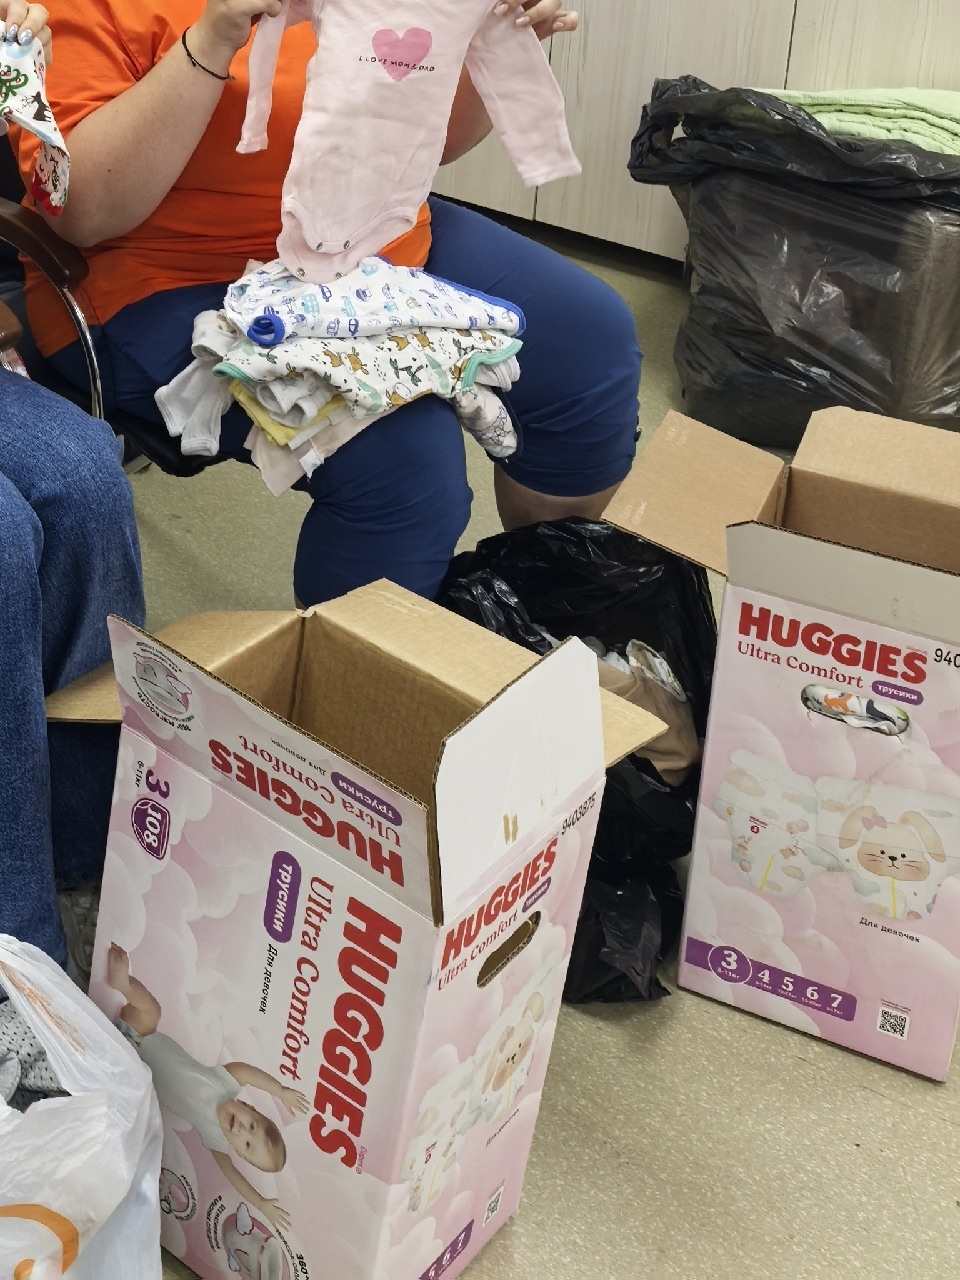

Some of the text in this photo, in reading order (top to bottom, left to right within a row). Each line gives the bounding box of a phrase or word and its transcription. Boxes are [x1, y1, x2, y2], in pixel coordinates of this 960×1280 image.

[737, 640, 864, 689] Ultra Comfort
[738, 602, 928, 684] HUGGIES
[145, 768, 170, 799] 3
[208, 739, 405, 887] HUGGIES
[239, 735, 402, 848] Ultra Comfort
[339, 778, 395, 819] трусики
[561, 791, 597, 836] 9403875
[143, 802, 162, 848] 108
[272, 863, 293, 934] трусики
[440, 836, 558, 971] HUGGIES
[859, 916, 921, 943] Для девочек
[258, 942, 279, 1015] Для девочек
[279, 876, 335, 1082] Ultra Comfort
[438, 908, 518, 991] Ultra Comfort
[721, 949, 738, 970] 3
[757, 969, 771, 984] 4
[781, 976, 795, 992] 5
[806, 986, 820, 1000] 6
[830, 993, 843, 1008] 7
[309, 896, 402, 1168] HUGGIES
[457, 1231, 467, 1249] 7
